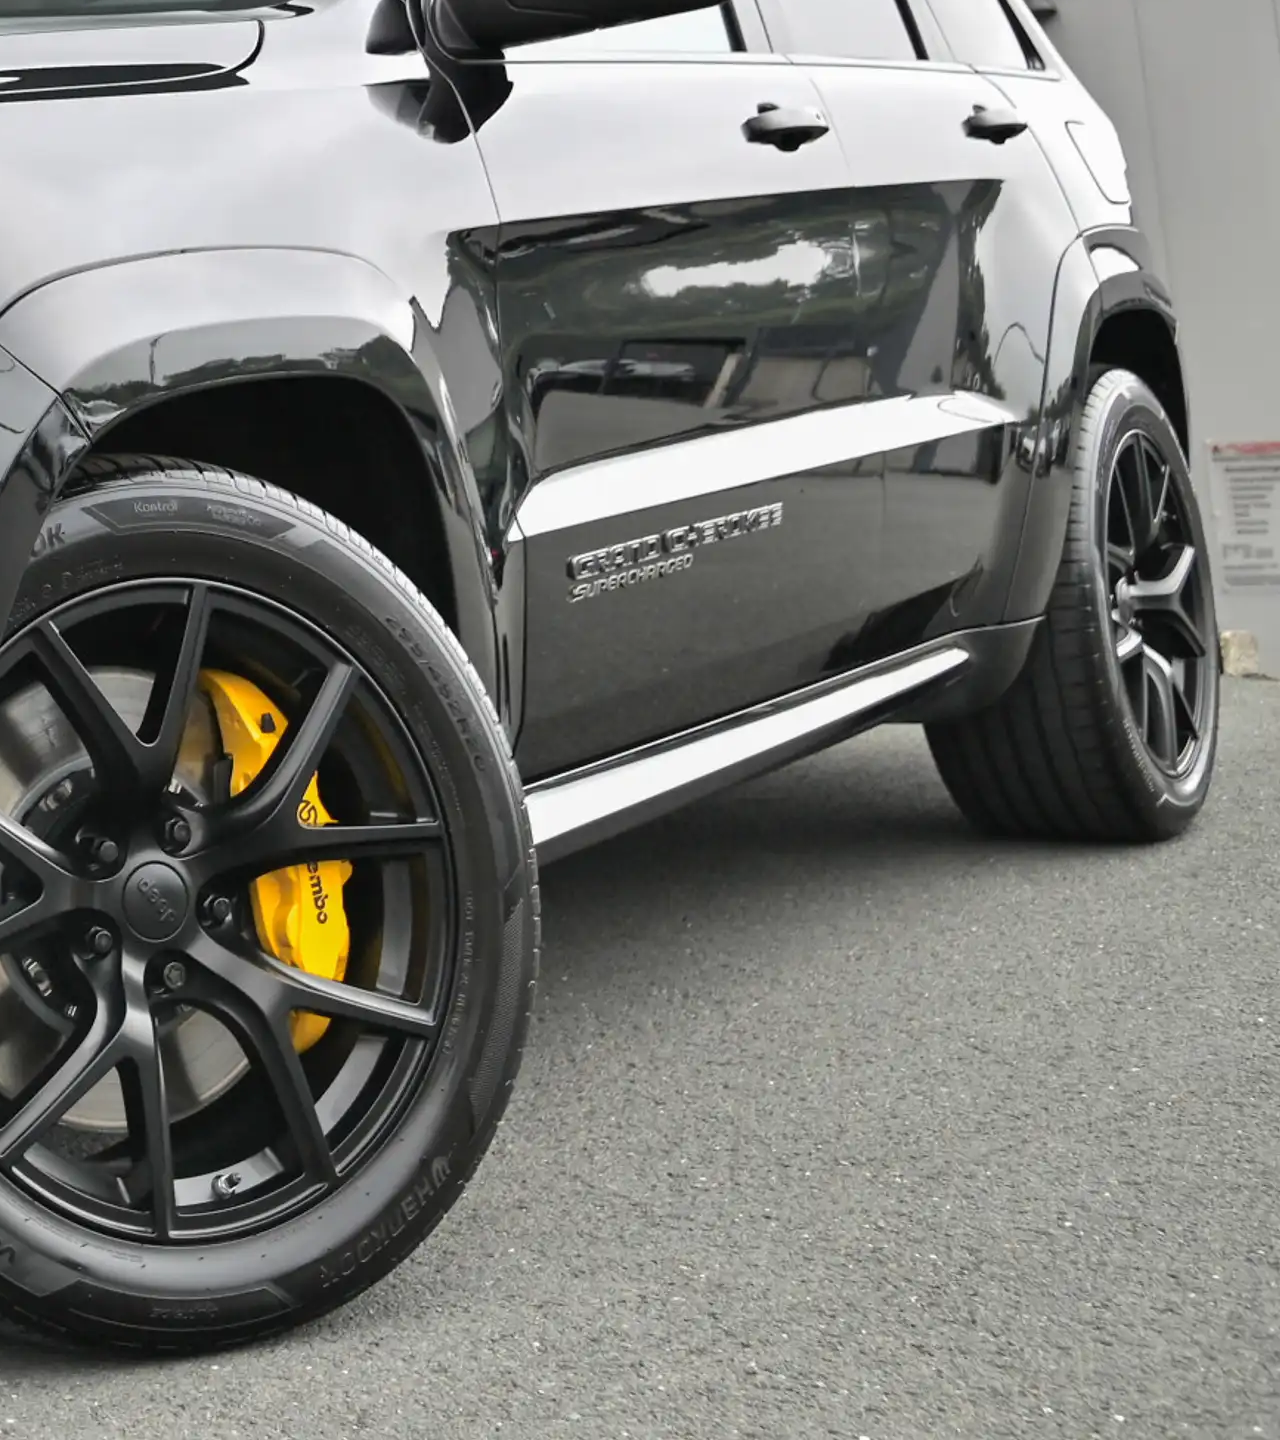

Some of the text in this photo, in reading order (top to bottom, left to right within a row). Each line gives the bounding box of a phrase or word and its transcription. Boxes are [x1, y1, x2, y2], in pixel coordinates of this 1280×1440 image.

[570, 501, 784, 581] GRAND CHEROKEE
[569, 552, 695, 604] SUPERCHARGED
